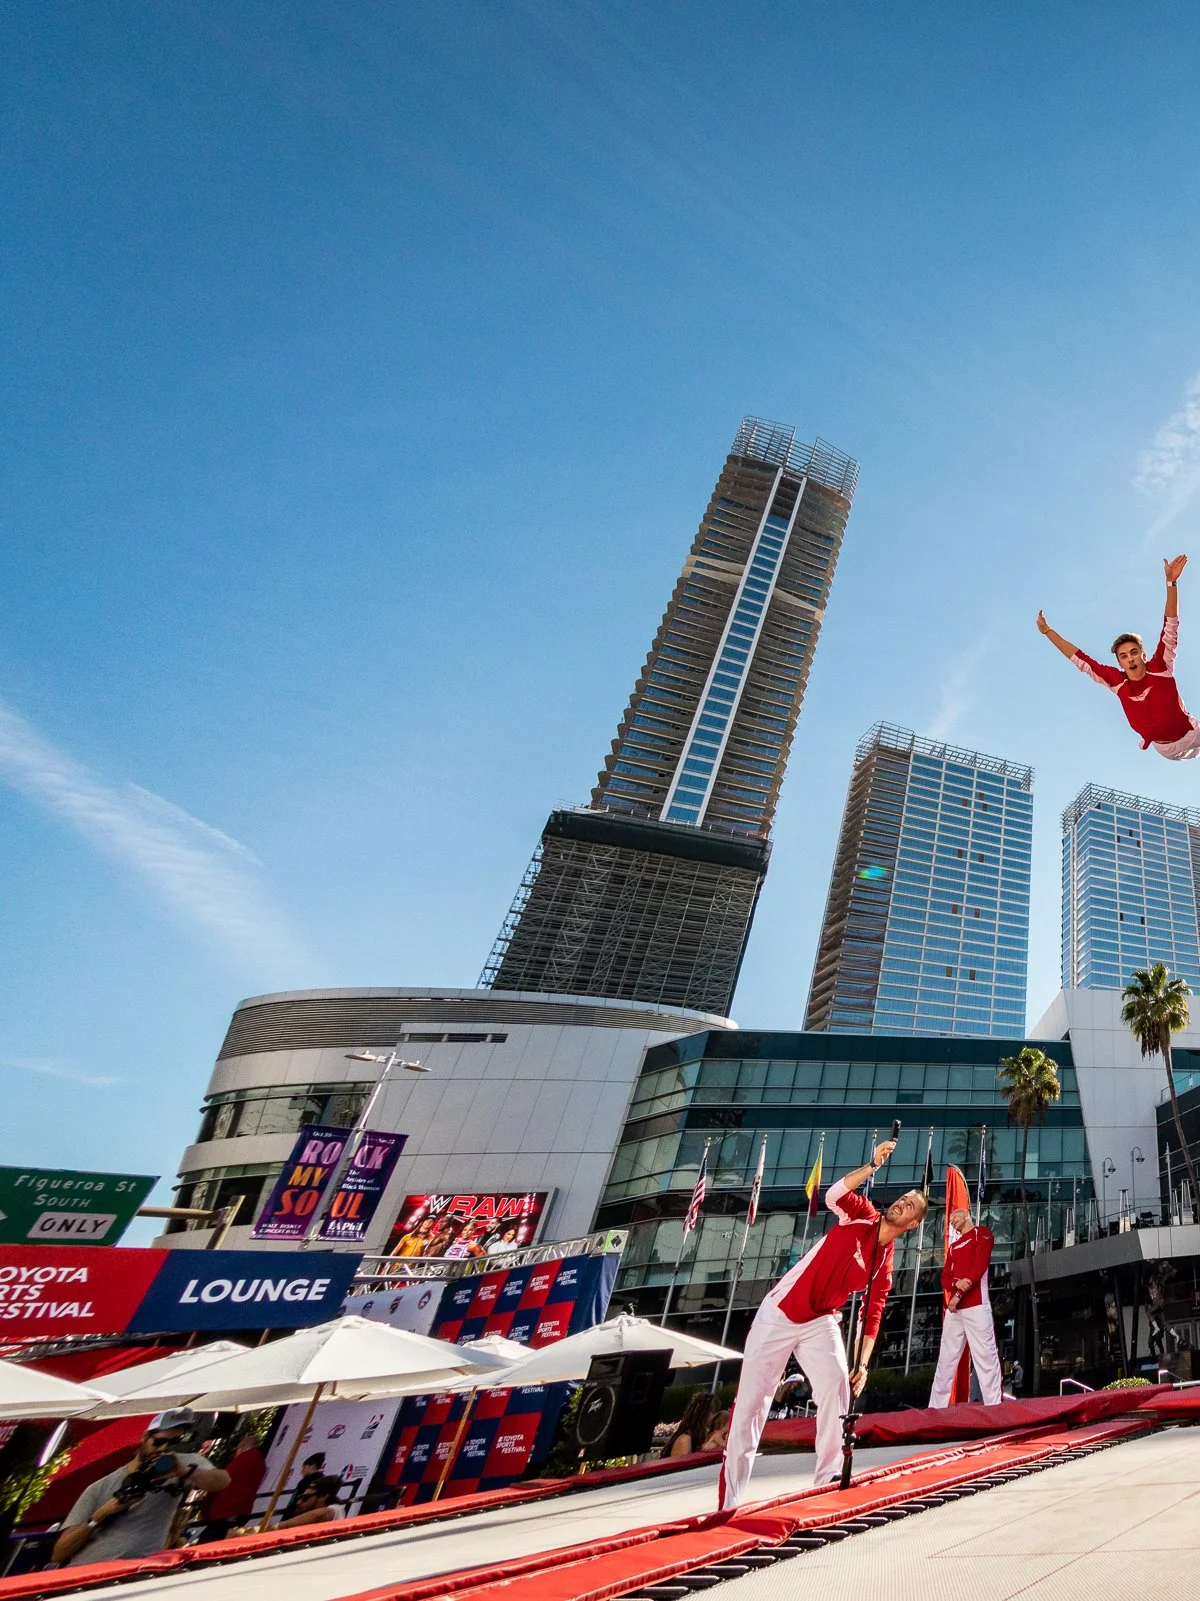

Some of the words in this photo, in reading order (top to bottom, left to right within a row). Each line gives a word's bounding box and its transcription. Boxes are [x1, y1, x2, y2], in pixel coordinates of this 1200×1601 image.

[300, 1140, 343, 1165] RO
[354, 1145, 390, 1169] CK
[14, 1175, 106, 1191] Figueroa
[115, 1181, 137, 1193] St
[288, 1166, 329, 1187] MY
[33, 1194, 92, 1208] SOUTH
[274, 1189, 319, 1217] SO
[331, 1192, 365, 1219] UL
[448, 1195, 526, 1219] RAW
[40, 1218, 109, 1233] ONLY
[0, 1266, 88, 1283] OYOTA
[0, 1284, 45, 1300] RTS
[179, 1278, 331, 1304] LOUNGE
[0, 1302, 95, 1319] ESTIVAL
[522, 1386, 544, 1394] FESTIVAL
[496, 1441, 515, 1449] SPORTS
[503, 1434, 524, 1442] TOYOTA
[501, 1446, 526, 1454] FESTIVAL
